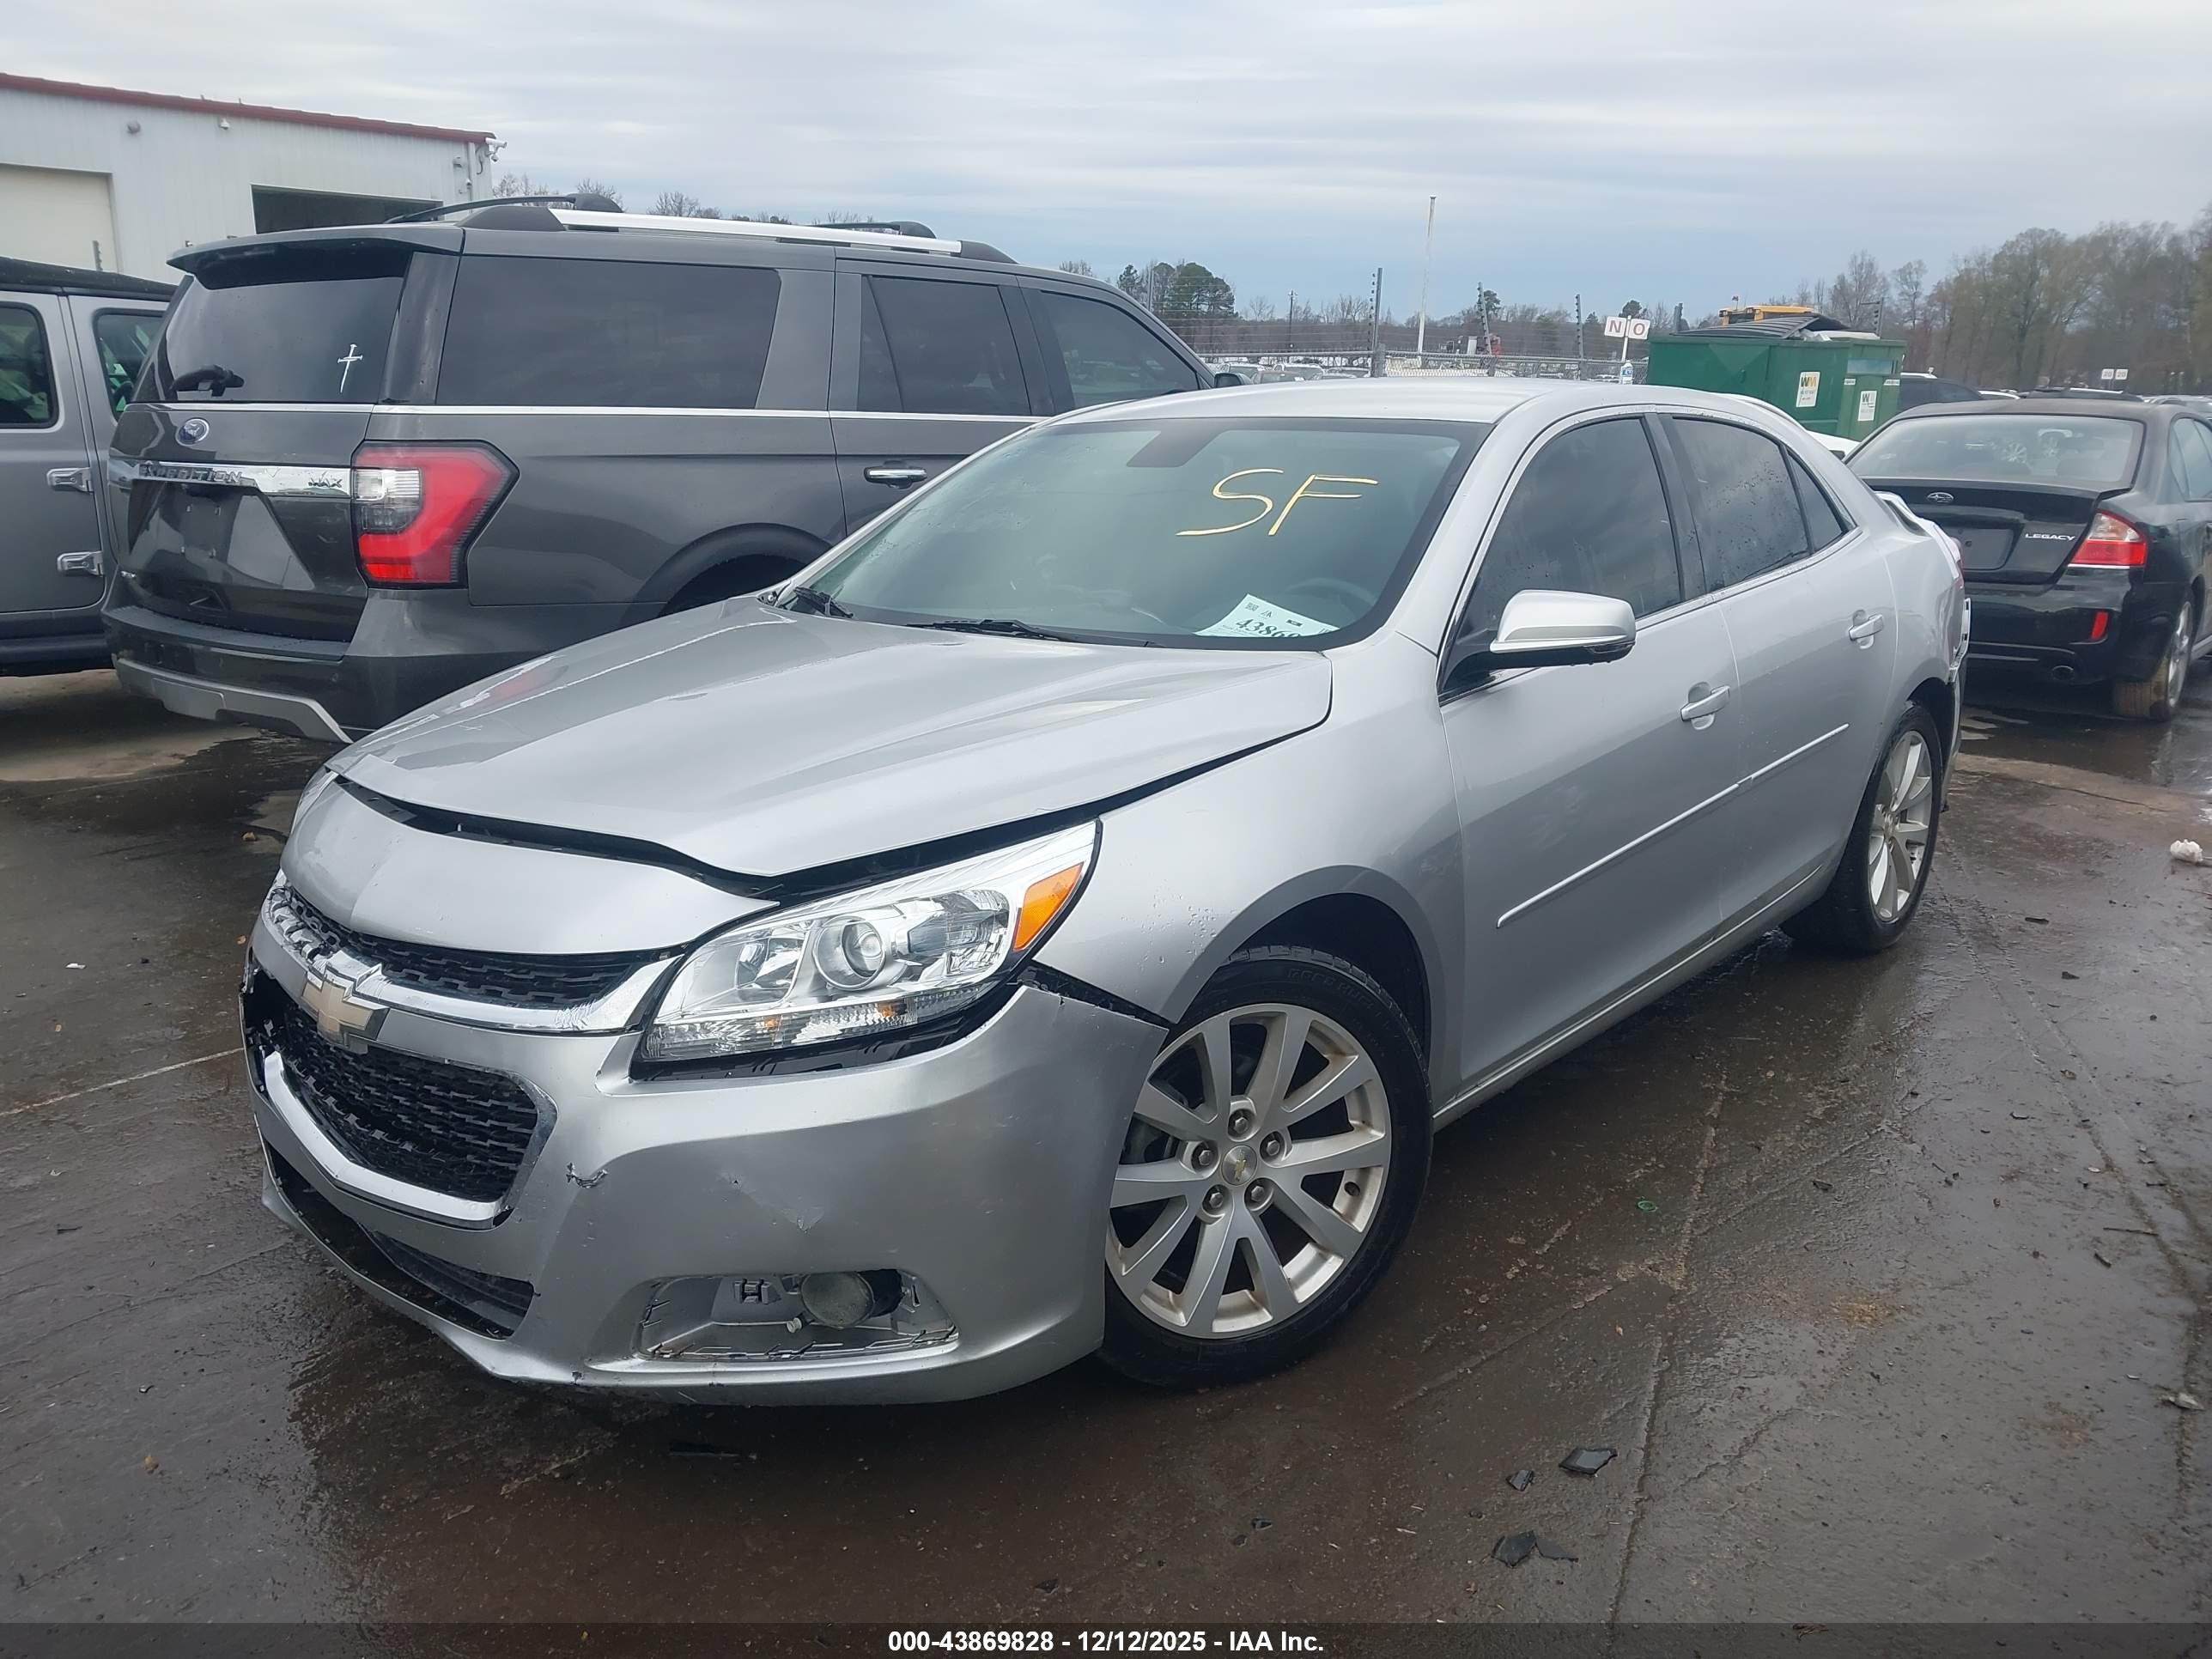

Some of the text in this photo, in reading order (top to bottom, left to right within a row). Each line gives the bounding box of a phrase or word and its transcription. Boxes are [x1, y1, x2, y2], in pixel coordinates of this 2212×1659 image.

[139, 460, 243, 483] EXPEDITION
[1175, 467, 1379, 536] SF
[2024, 532, 2075, 542] LEGACY
